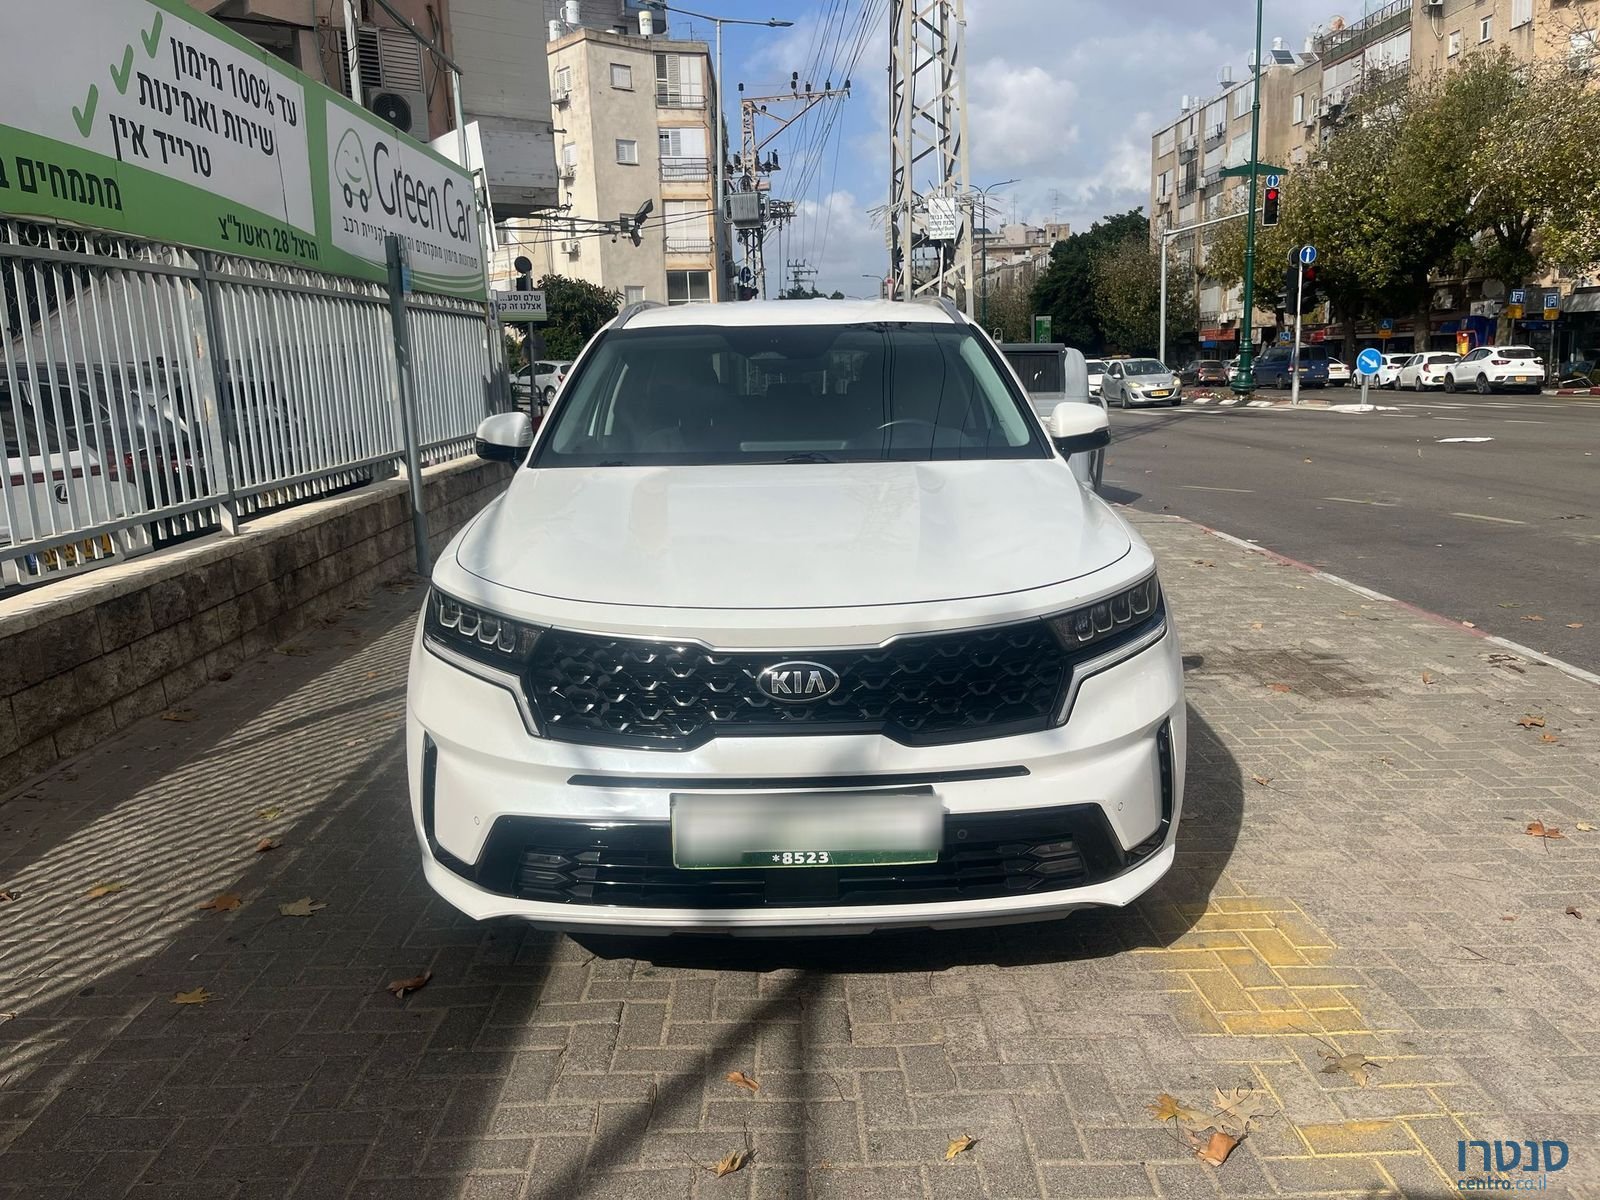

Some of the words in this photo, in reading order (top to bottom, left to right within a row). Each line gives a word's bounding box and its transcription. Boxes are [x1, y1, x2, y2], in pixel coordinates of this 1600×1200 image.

[170, 36, 223, 91] מימון
[137, 71, 219, 134] ואמינות
[227, 64, 275, 116] 100%
[276, 93, 297, 127] עד
[109, 113, 149, 161] אין
[222, 109, 274, 156] שירות
[152, 129, 212, 178] טרייד
[16, 156, 122, 211] מתמחים
[373, 141, 442, 232] Green
[443, 178, 472, 243] Car
[273, 227, 290, 254] 28
[342, 215, 360, 236] רכב
[361, 222, 388, 246] לקניית
[290, 231, 319, 261] הרצל
[416, 239, 443, 261] מתקדמים
[520, 302, 542, 310] אצלנו
[523, 293, 541, 302] שלם
[771, 670, 827, 694] KIA
